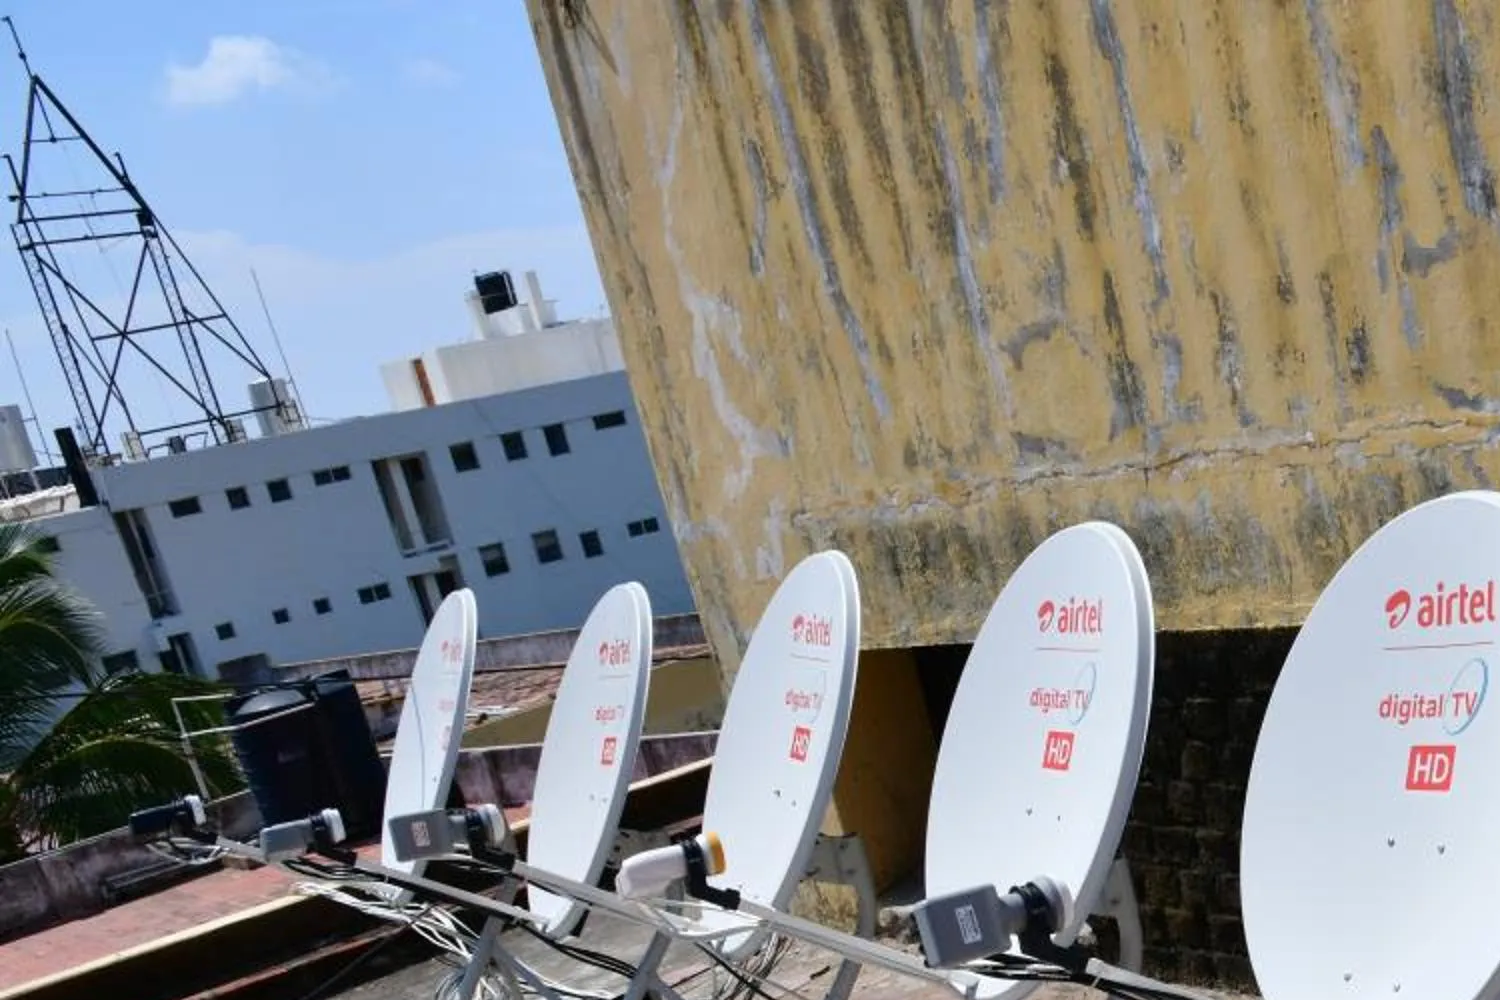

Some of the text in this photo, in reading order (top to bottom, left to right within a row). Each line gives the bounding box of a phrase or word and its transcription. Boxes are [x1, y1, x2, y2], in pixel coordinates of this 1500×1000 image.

[1057, 597, 1103, 633] airtel
[1418, 579, 1496, 628] airtel
[805, 613, 832, 646] airtel
[1029, 687, 1071, 713] digital
[1379, 692, 1478, 725] digital TV
[1047, 737, 1071, 764] HD
[1413, 751, 1450, 784] HD
